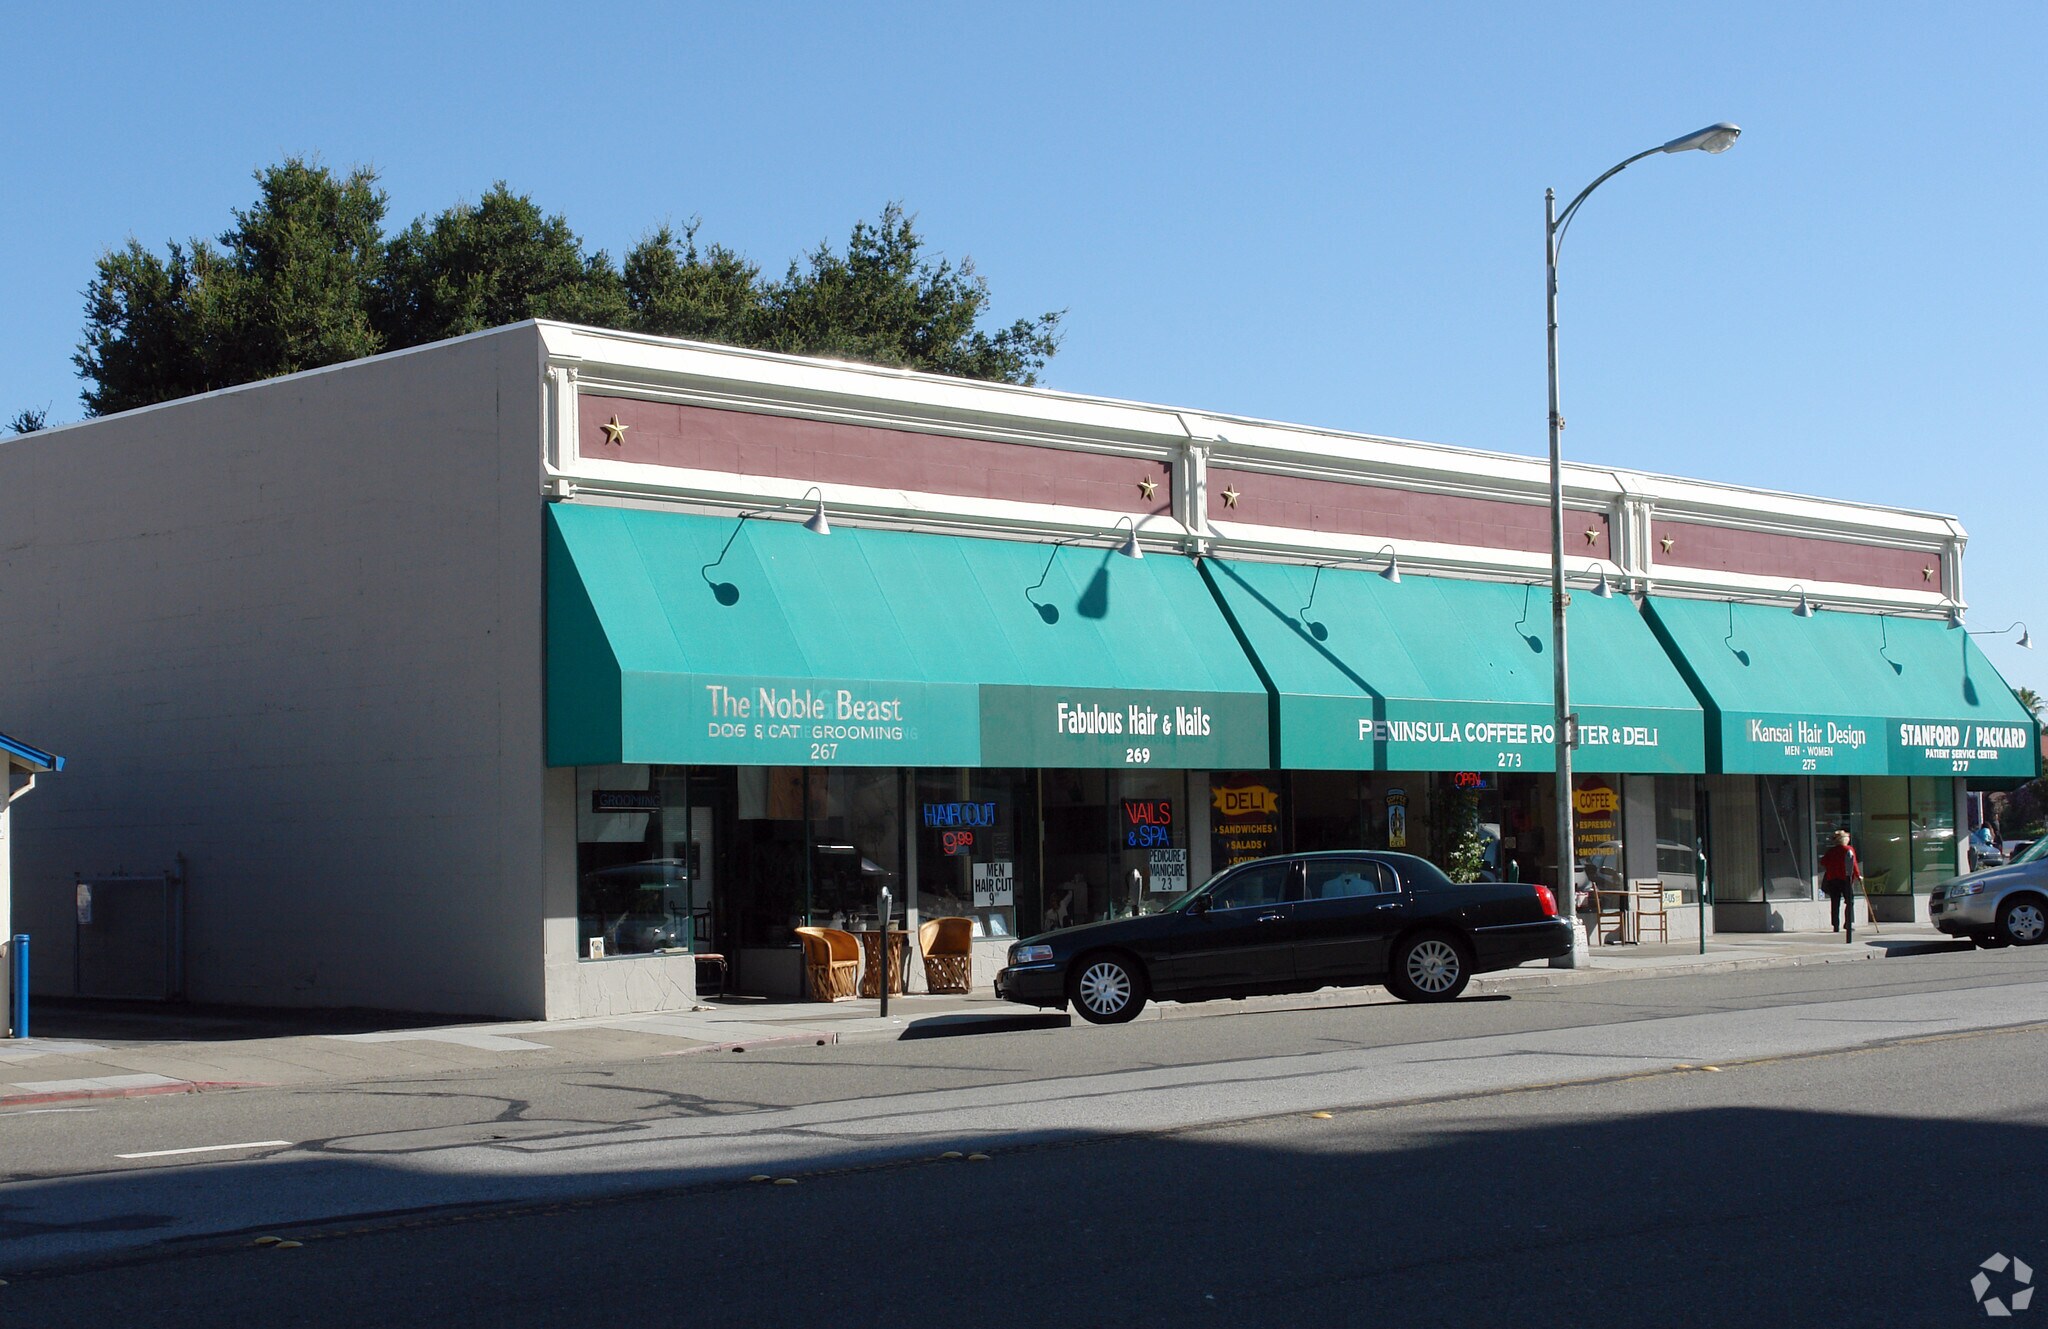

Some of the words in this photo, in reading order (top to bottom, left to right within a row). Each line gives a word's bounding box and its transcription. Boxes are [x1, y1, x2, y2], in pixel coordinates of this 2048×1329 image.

[706, 685, 750, 718] The
[759, 687, 825, 719] Noble
[837, 690, 903, 721] Beast
[1057, 702, 1123, 734] Fabulous
[1128, 704, 1158, 735] Hair
[1162, 714, 1172, 736] &
[1176, 706, 1211, 736] Nails
[708, 722, 747, 738] DOG
[754, 724, 764, 740] &
[768, 724, 801, 739] CAT
[812, 726, 903, 740] GROOMING
[1358, 719, 1462, 742] PENINSULA
[1464, 722, 1528, 744] COFFEE
[1530, 724, 1610, 745] ROTER
[1612, 728, 1621, 744] &
[1622, 726, 1658, 746] DELI
[1751, 719, 1793, 742] Kansai
[1798, 721, 1822, 744] Hair
[1827, 721, 1866, 749] Design
[1900, 723, 1960, 747] STANFORD
[1976, 726, 2027, 748] PACKARD
[810, 743, 839, 760] 267
[1126, 748, 1150, 763] 269
[1784, 746, 1800, 756] MEN
[1806, 746, 1834, 757] WOMEN
[1925, 748, 1950, 759] PATIENT
[1951, 749, 1976, 759] SERVICE
[1977, 750, 1998, 760] CENTER
[1498, 752, 1522, 768] 273
[1802, 759, 1817, 770] 275
[1952, 760, 1969, 772] 277
[1225, 791, 1265, 810] DELI
[1580, 792, 1611, 809] COFFEE
[923, 803, 962, 827] HAIR
[1218, 824, 1273, 835] SANDWICHES
[1579, 820, 1613, 830] ESPRESSO
[1128, 831, 1137, 846] &
[1139, 825, 1170, 847] SPA
[1231, 840, 1263, 850] SALADS
[1149, 849, 1181, 863] PEDICURE
[986, 863, 1004, 877] MEN
[1150, 863, 1185, 877] MANICURE
[975, 878, 994, 893] HAIR
[995, 877, 1012, 892] CUT
